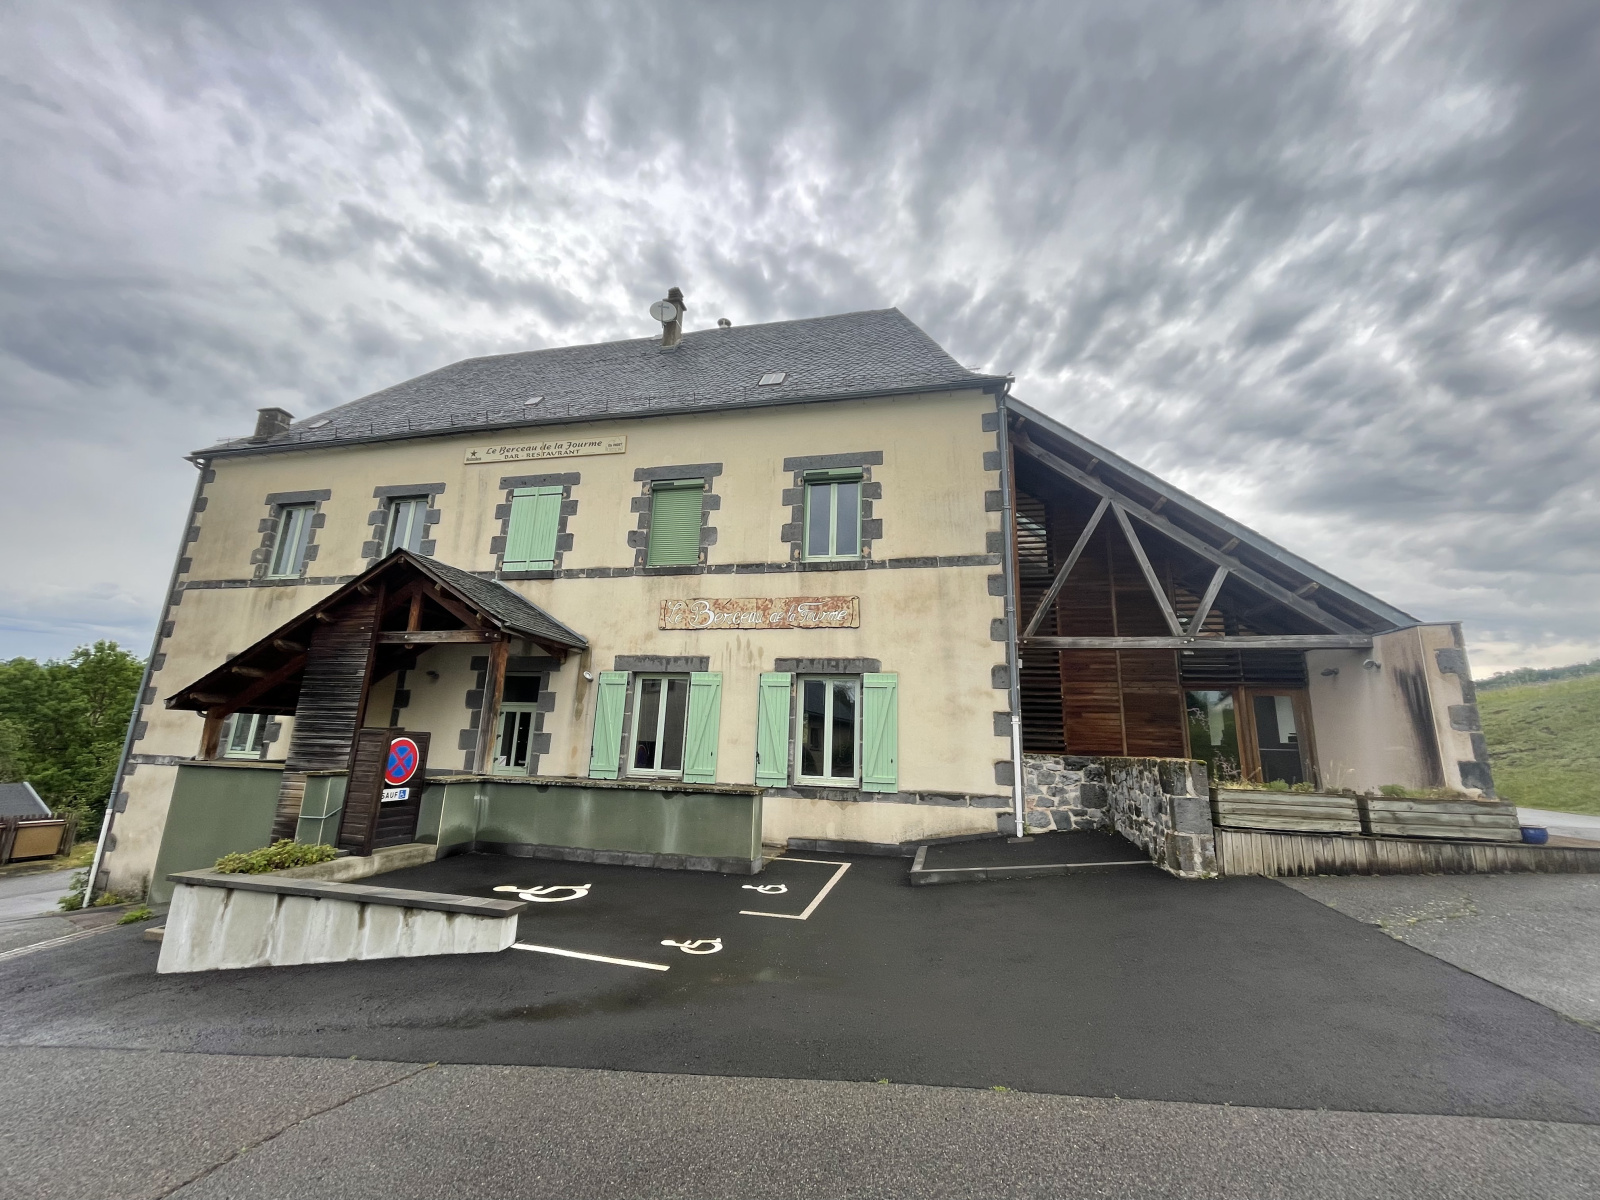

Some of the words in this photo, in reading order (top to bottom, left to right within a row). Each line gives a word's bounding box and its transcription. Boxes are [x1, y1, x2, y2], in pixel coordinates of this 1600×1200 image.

[486, 447, 497, 455] Le
[499, 445, 537, 455] Berceau
[554, 442, 563, 450] la
[666, 601, 682, 624] Le
[689, 600, 763, 628] Berceau
[787, 604, 796, 622] la
